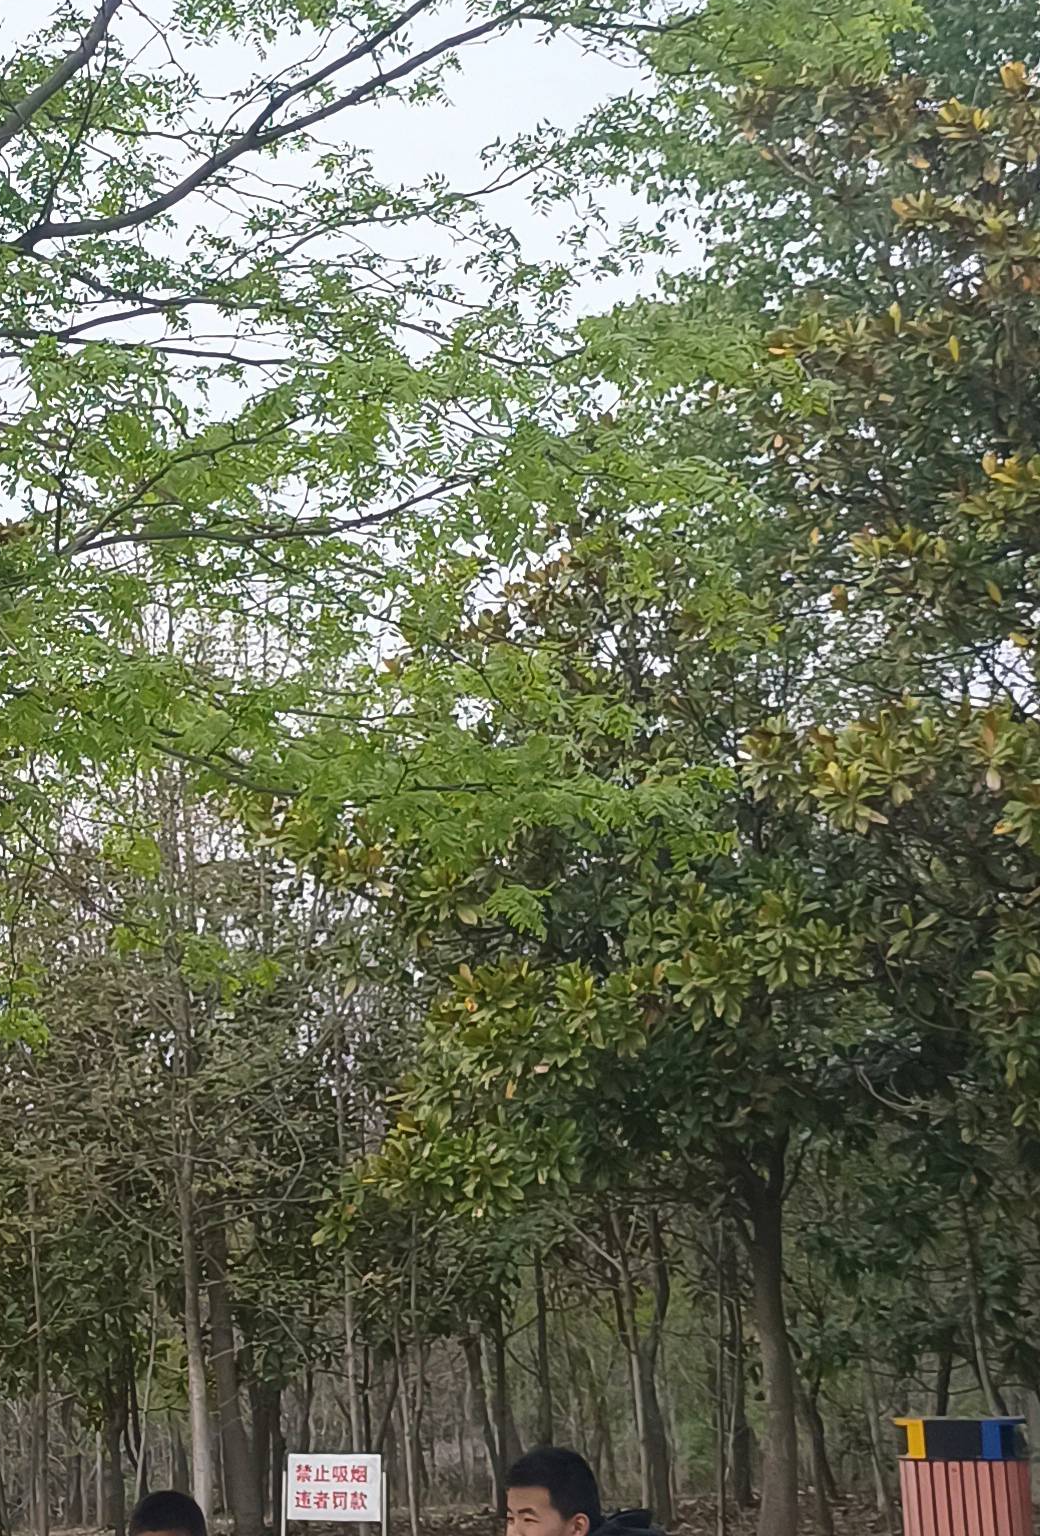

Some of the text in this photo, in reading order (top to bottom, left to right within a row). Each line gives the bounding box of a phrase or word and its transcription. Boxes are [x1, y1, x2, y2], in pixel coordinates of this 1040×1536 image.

[296, 1464, 367, 1483] 禁止吸烟
[295, 1490, 367, 1510] 违者罚款
